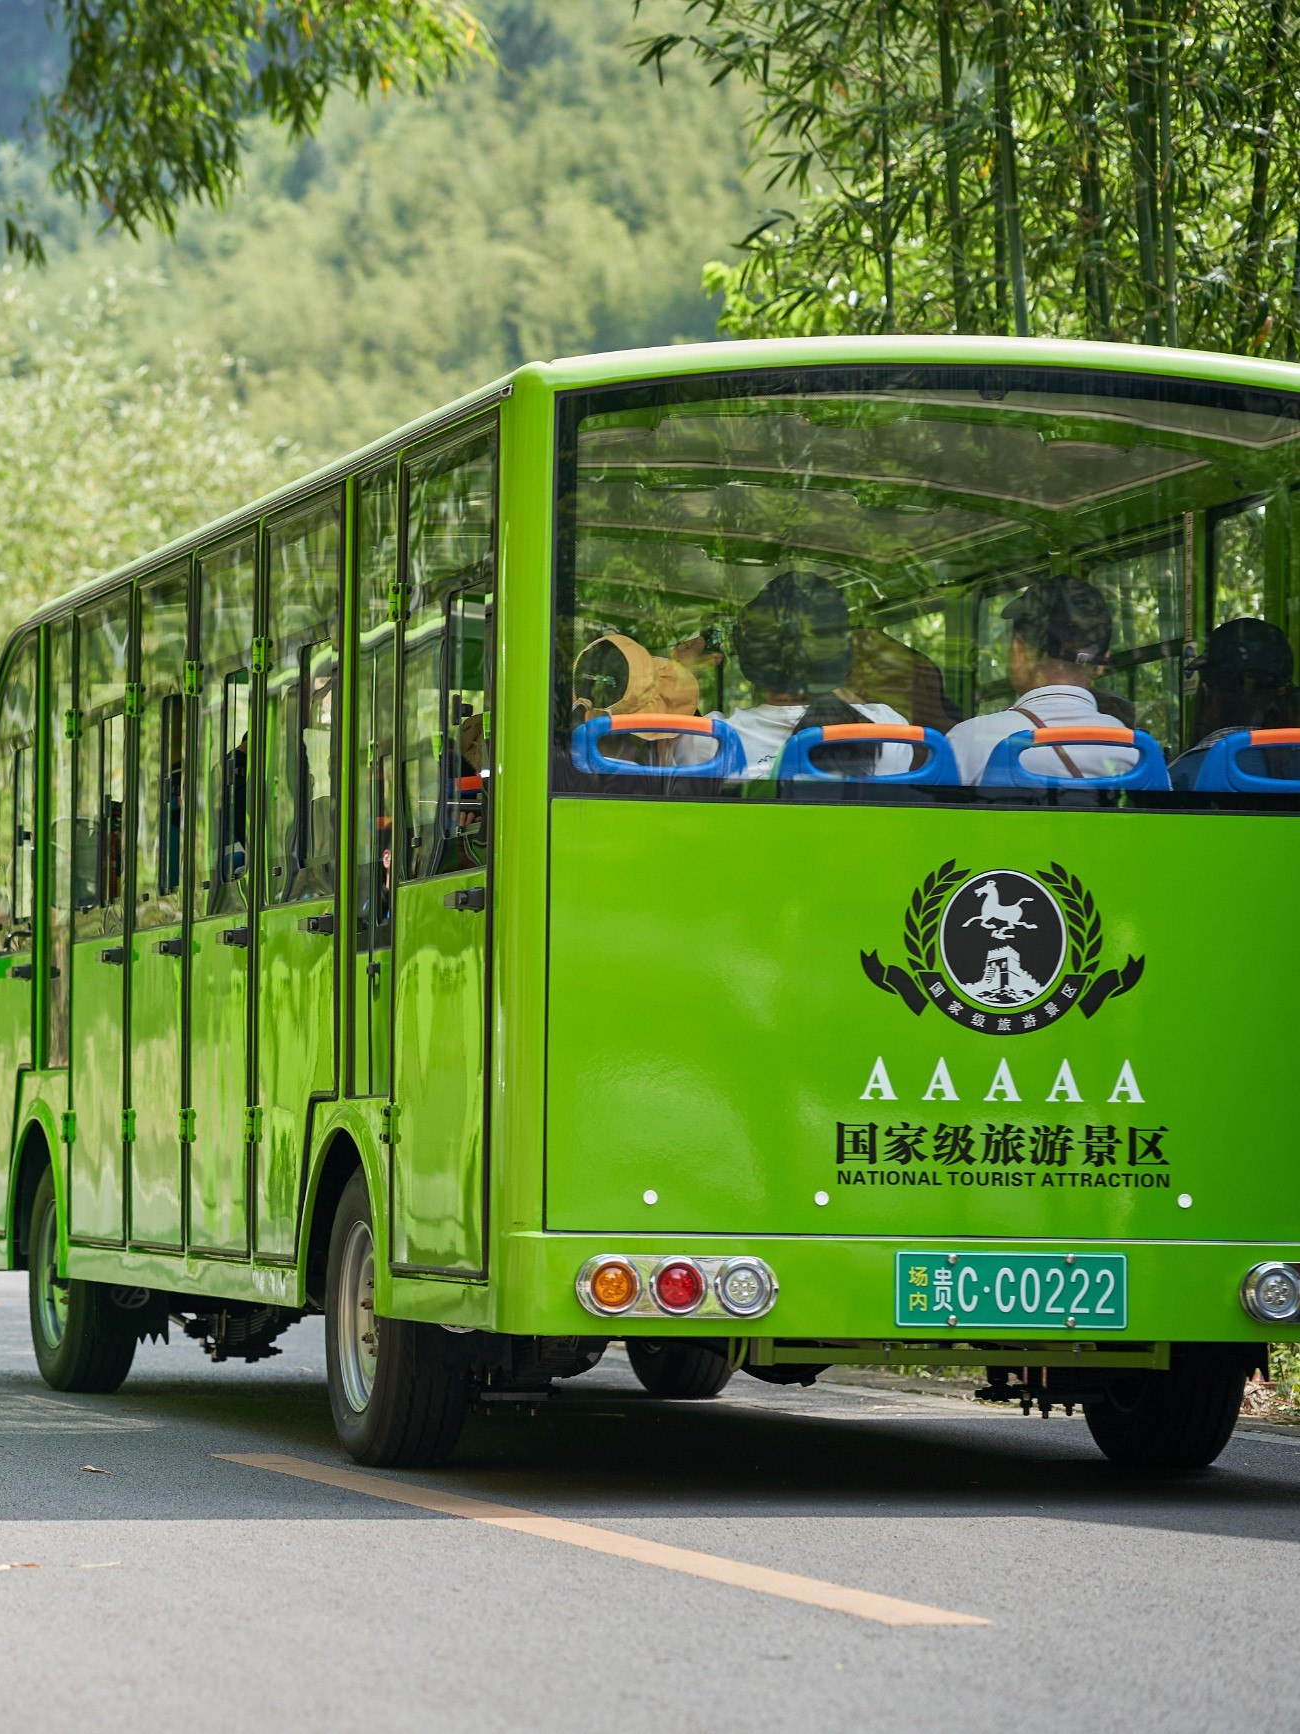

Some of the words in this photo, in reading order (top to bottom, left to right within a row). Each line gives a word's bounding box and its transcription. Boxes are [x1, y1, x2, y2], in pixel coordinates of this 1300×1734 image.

[928, 981, 1078, 1031] 国家级旅游景区
[835, 1121, 1171, 1168] 国家级旅游景区
[837, 1170, 943, 1186] NATIONAL
[946, 1171, 1037, 1187] TOURIST
[1040, 1172, 1171, 1189] ATTRACTION
